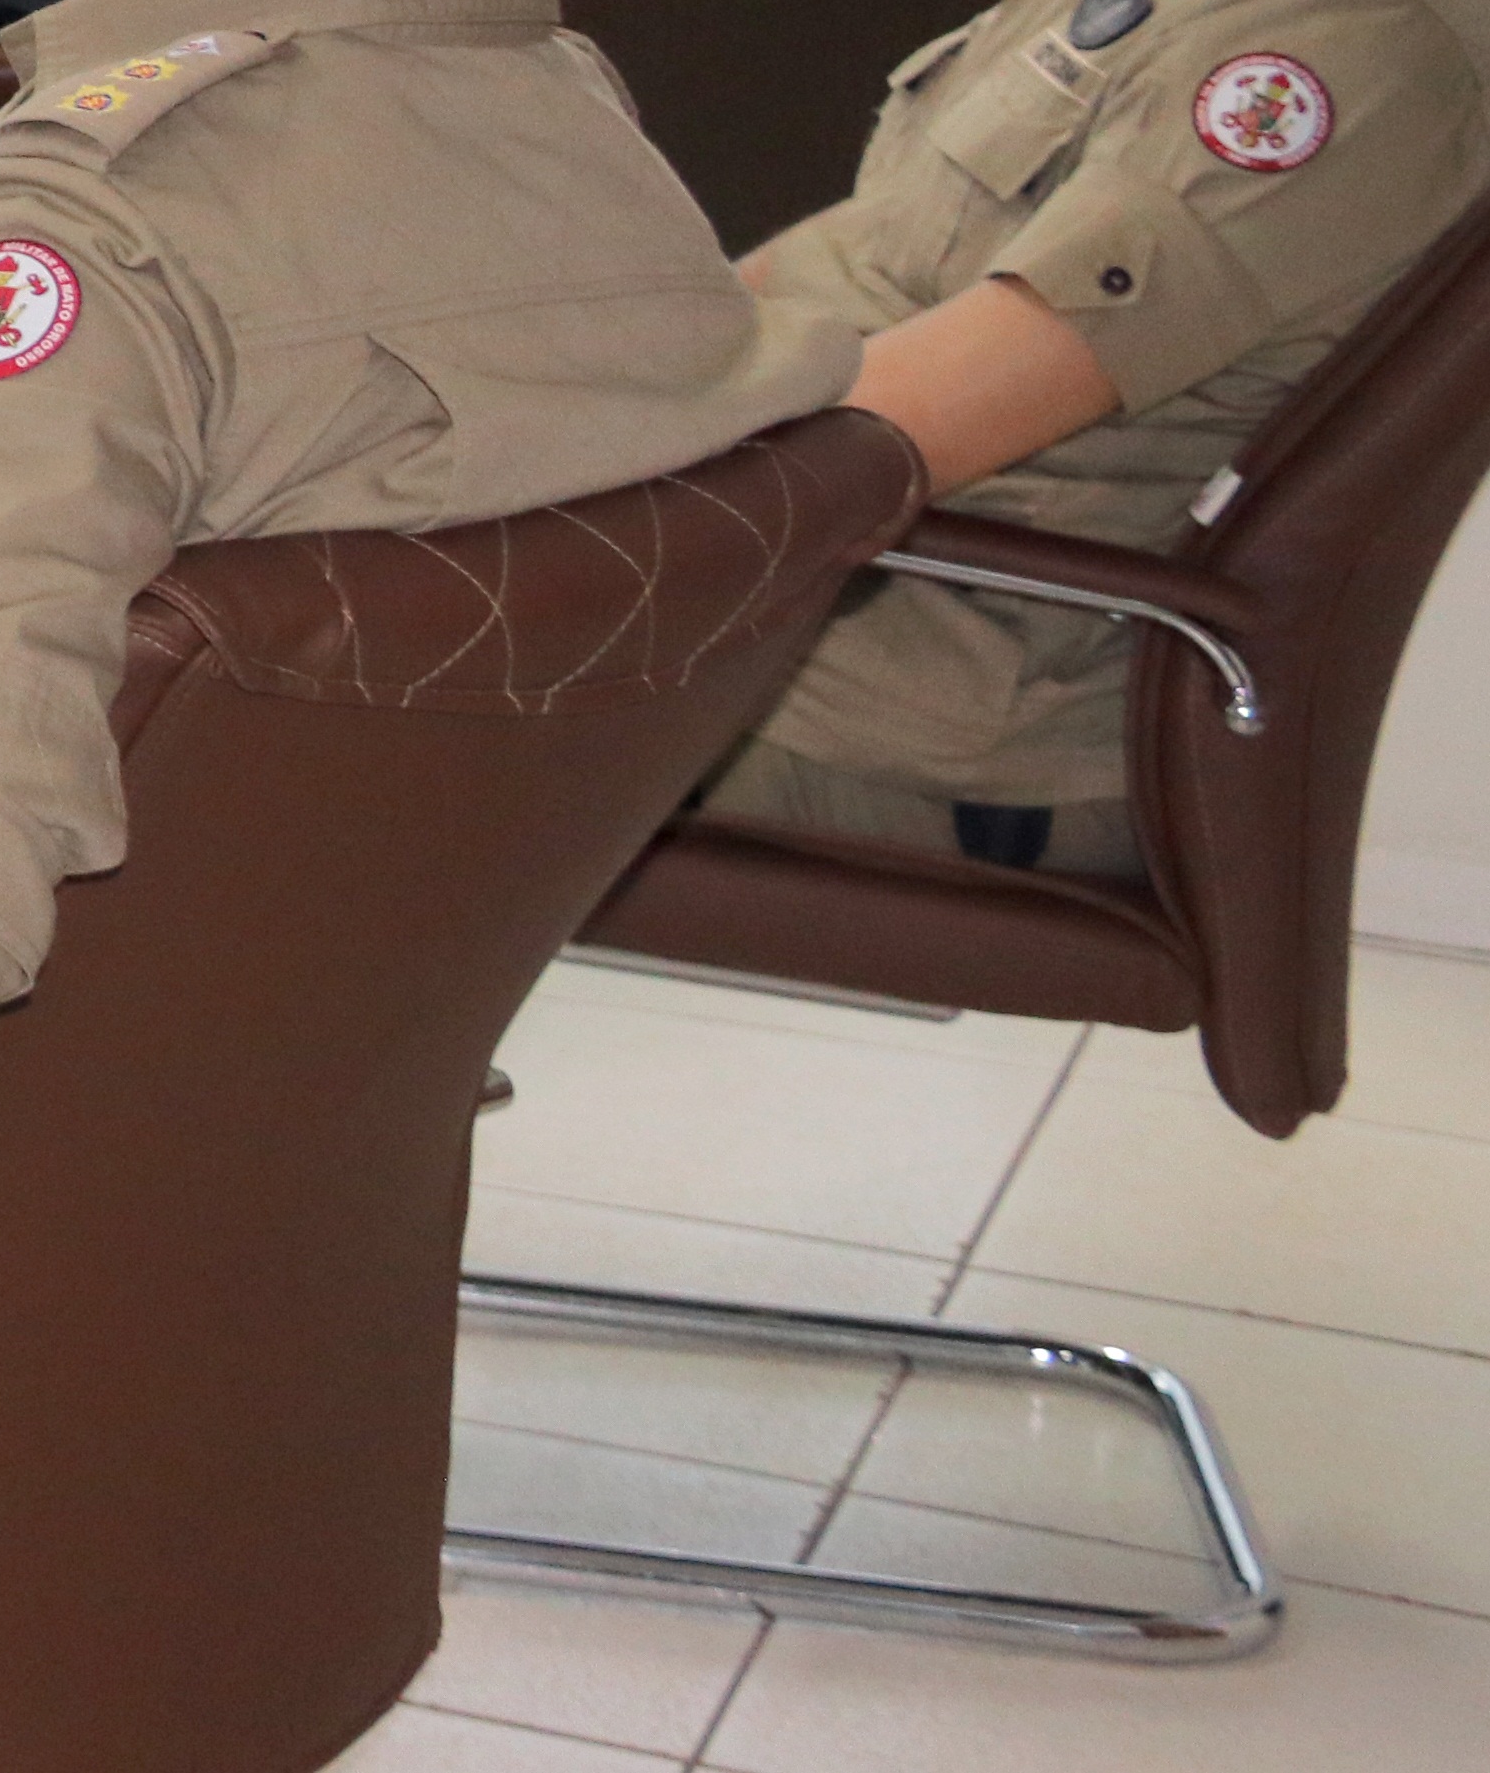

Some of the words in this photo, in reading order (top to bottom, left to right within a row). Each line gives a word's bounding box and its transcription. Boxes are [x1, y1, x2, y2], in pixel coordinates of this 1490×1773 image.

[52, 265, 70, 283] DE
[59, 283, 75, 321] MATO
[15, 322, 66, 368] GROSSO
